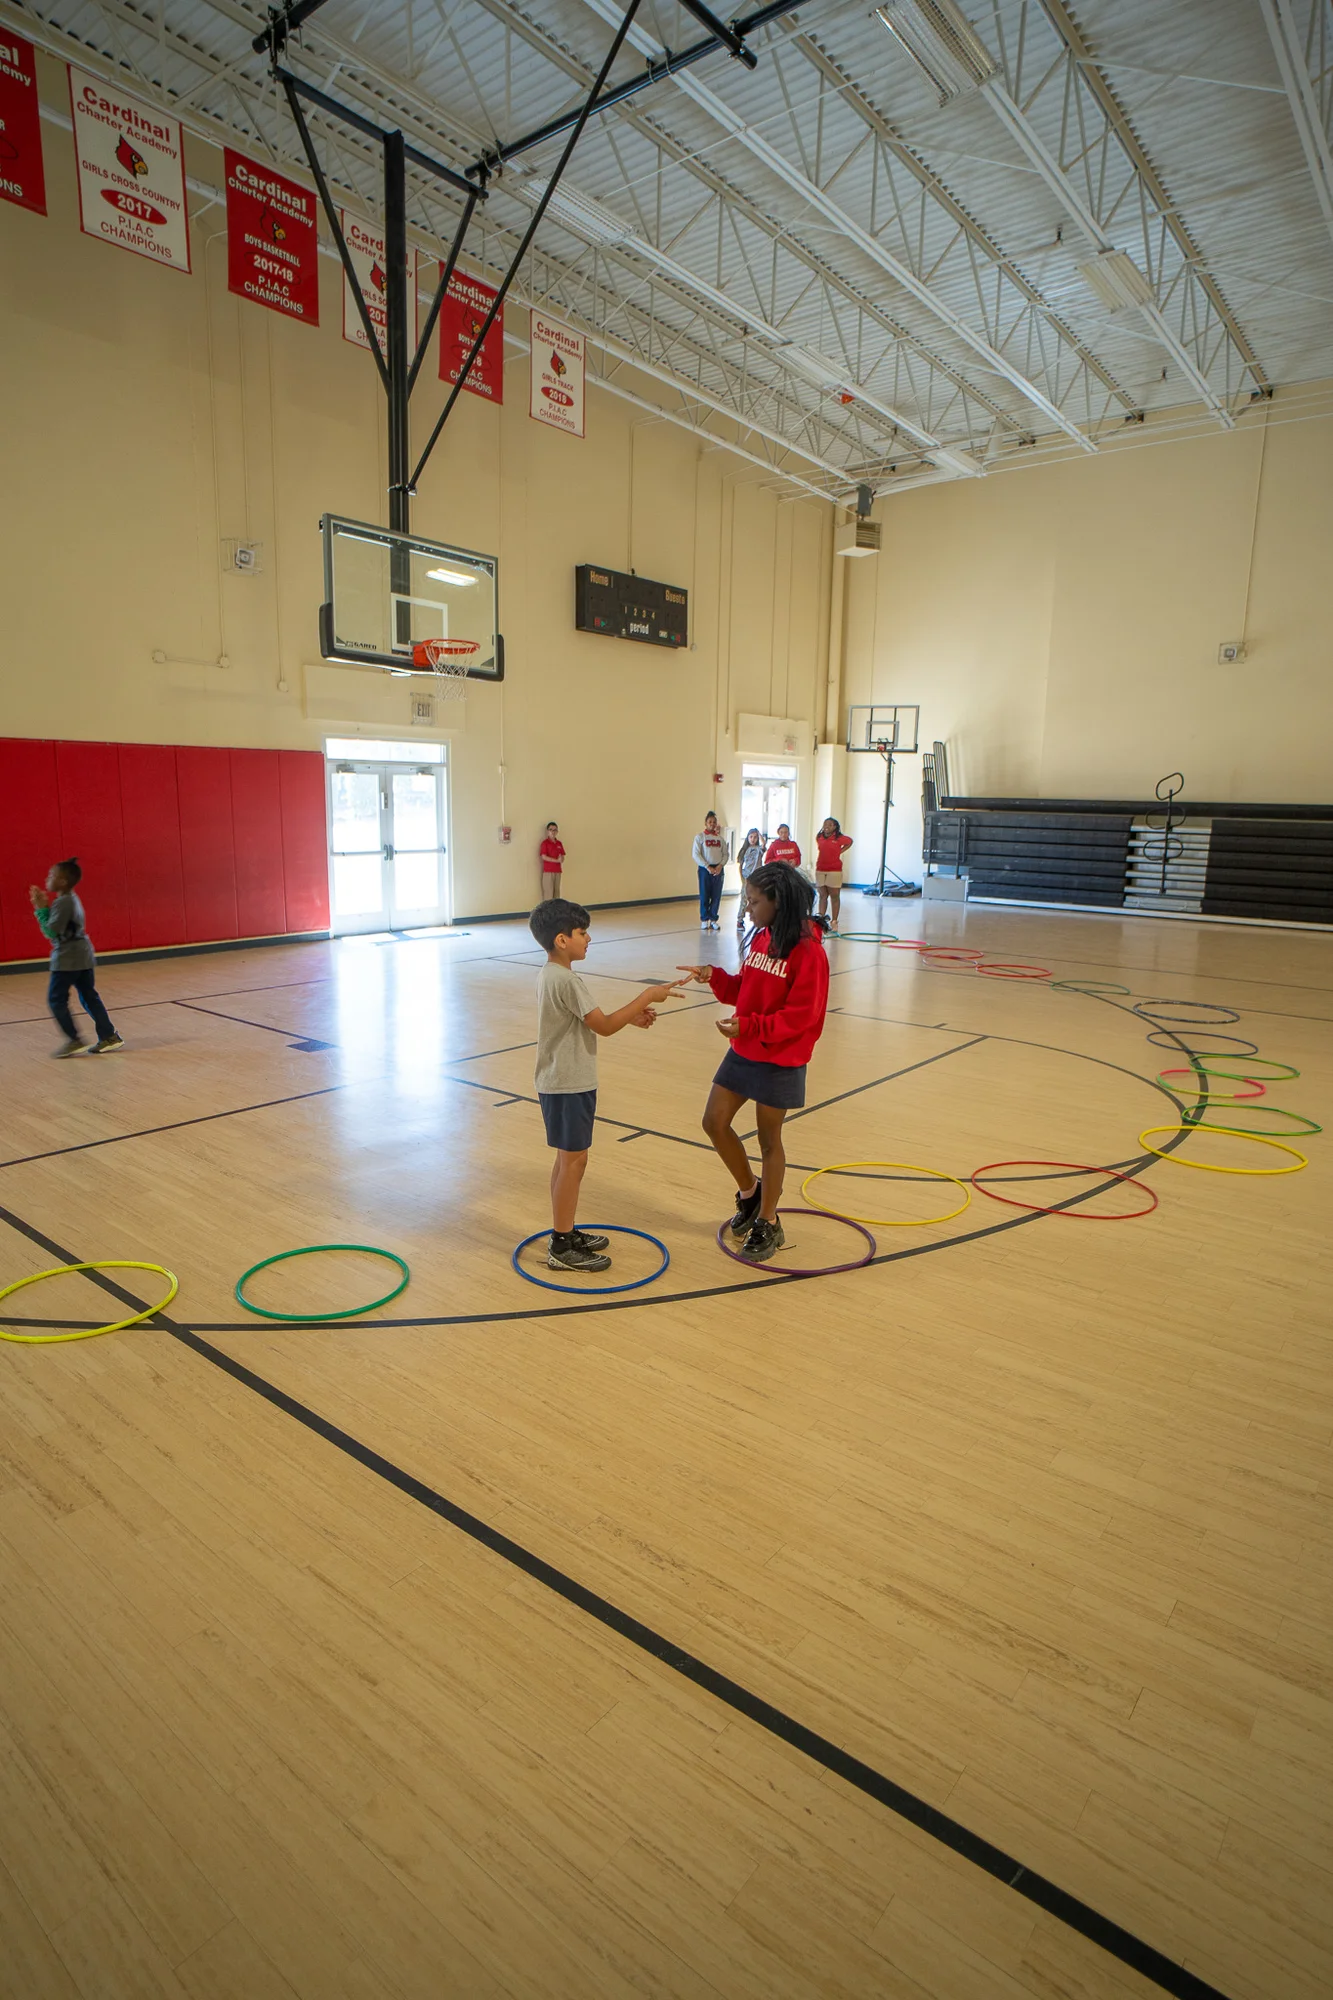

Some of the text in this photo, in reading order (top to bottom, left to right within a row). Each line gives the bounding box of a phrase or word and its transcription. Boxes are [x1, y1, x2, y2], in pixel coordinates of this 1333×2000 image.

[83, 86, 170, 142] Cardinal
[77, 101, 178, 159] Charter Academy
[82, 160, 181, 211] GIRLS CROSS COUNTRY
[235, 164, 307, 212] Cardinal
[117, 193, 152, 219] 2017
[228, 177, 313, 228] Charter Academy
[100, 221, 172, 258] CHAMPIONS
[118, 215, 154, 238] P.I.A.C
[244, 233, 300, 268] BOYS BASKETBALL
[346, 237, 377, 259] Charter
[253, 254, 294, 283] 2017-18
[244, 281, 303, 314] CHAMPIONS
[258, 275, 290, 297] P.I.A.C
[446, 288, 468, 305] harter
[448, 276, 497, 309] Cardina
[533, 332, 582, 362] Charter Academy
[537, 322, 580, 351] Cardinal
[449, 370, 492, 395] CHMPIONS
[541, 373, 574, 392] GIRLS TRACK
[549, 389, 567, 405] 2018
[540, 409, 575, 430] CHAMPIONS
[590, 571, 608, 587] Home
[633, 607, 638, 617] 2
[641, 609, 646, 618] 3
[651, 611, 656, 620] 4
[629, 622, 649, 634] period
[745, 951, 788, 979] ARDINAL
